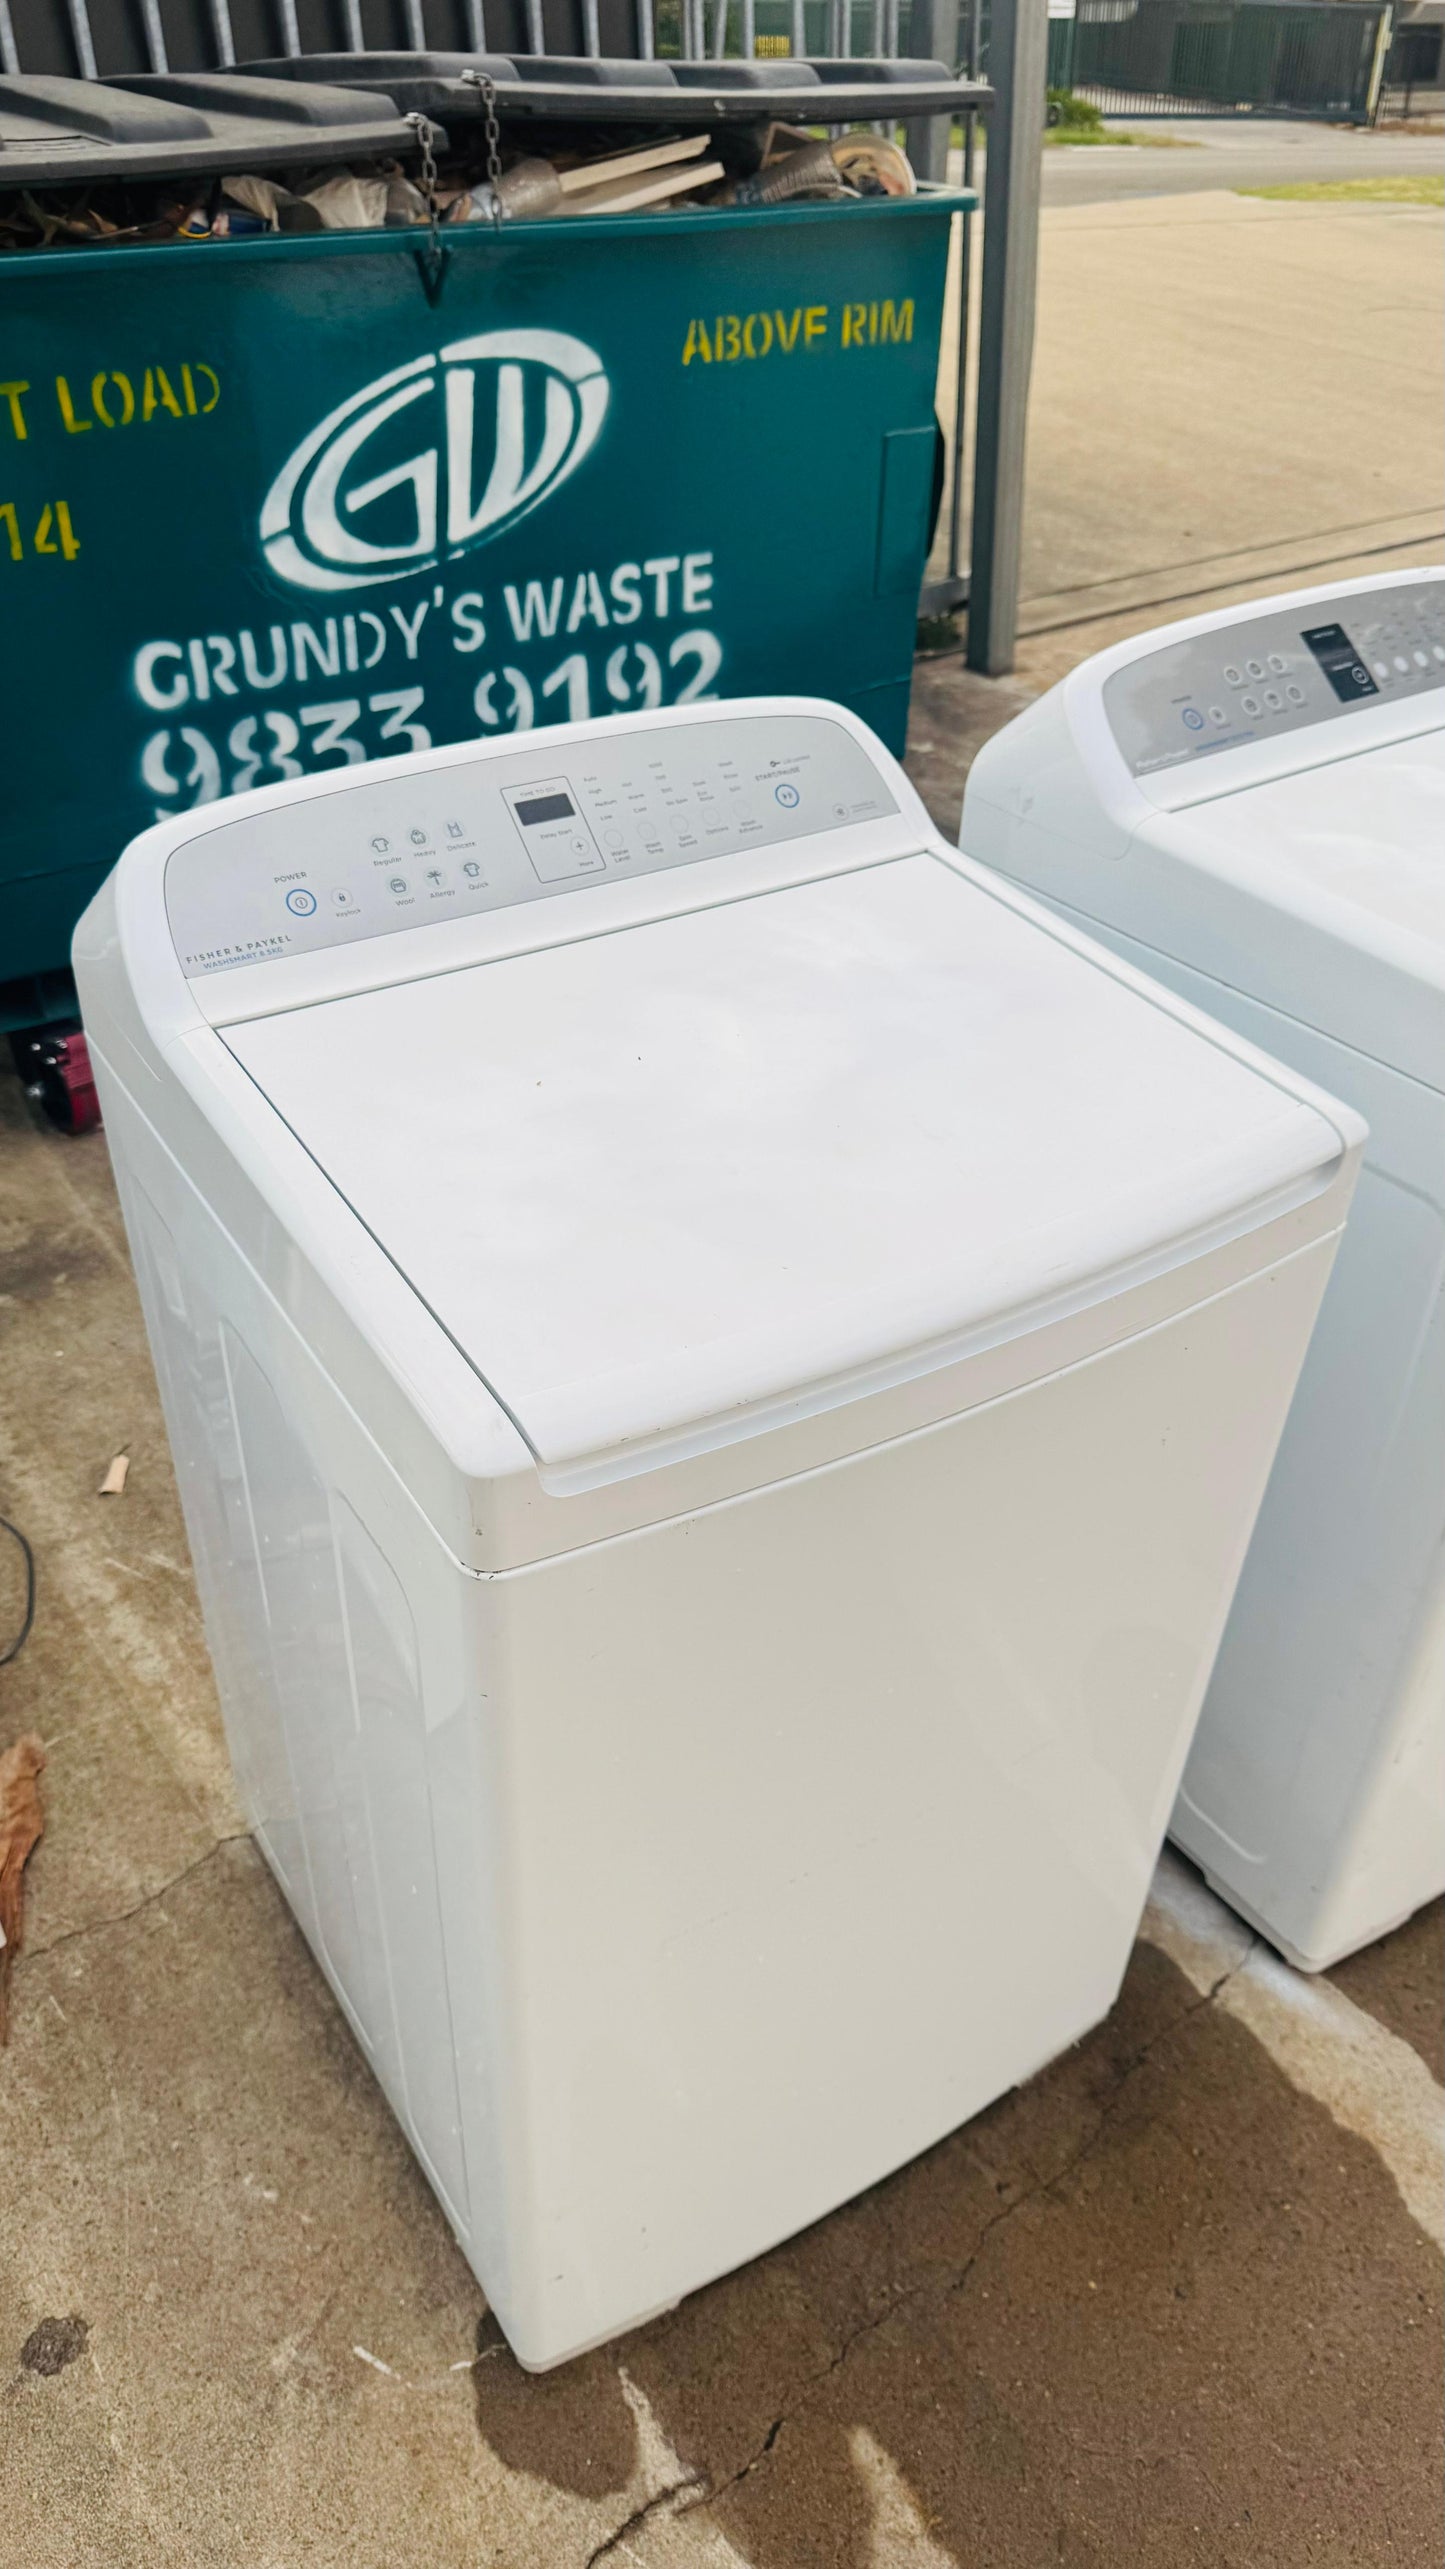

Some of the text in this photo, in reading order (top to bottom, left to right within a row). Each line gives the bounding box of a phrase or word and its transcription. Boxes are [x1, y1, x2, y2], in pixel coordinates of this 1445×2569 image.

[841, 299, 914, 349] RIM
[56, 363, 220, 433] LOAD
[301, 363, 575, 564] GW
[134, 551, 713, 710] GRUNDY'S WASTE
[474, 629, 722, 733] 9192
[373, 857, 402, 867] Regular
[274, 871, 308, 884] POWER
[468, 882, 489, 891] Quick
[395, 898, 415, 907] Wool
[430, 889, 455, 899] Allergy
[186, 935, 292, 965] FISHER & PAYKEL
[203, 952, 257, 969] WASHSMART
